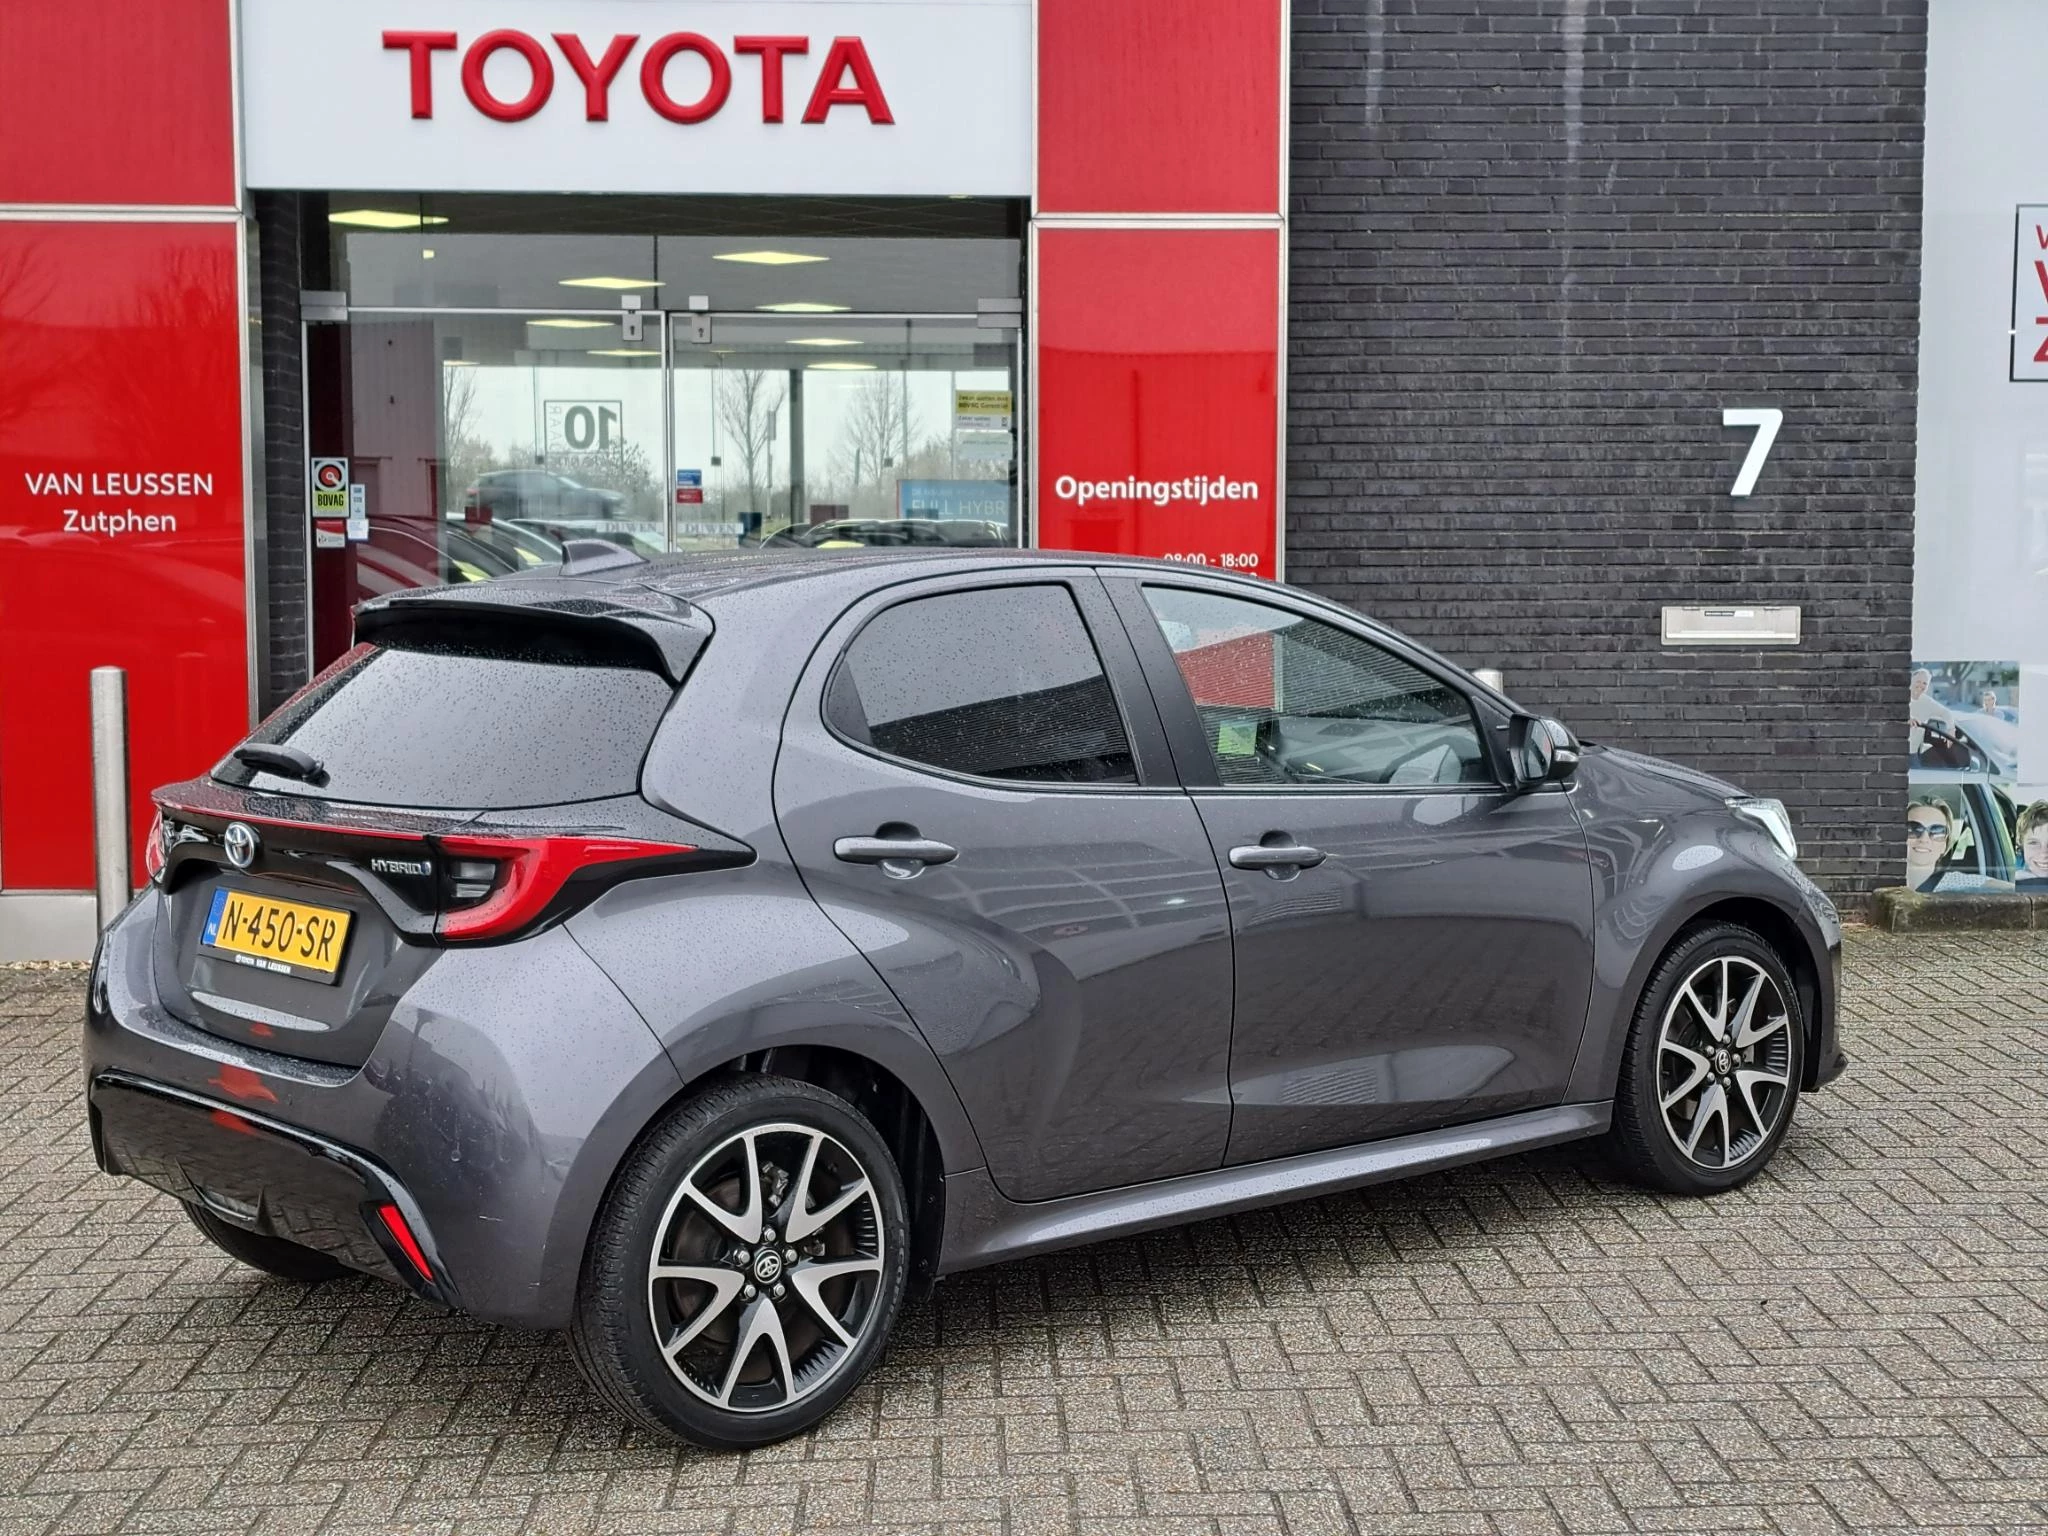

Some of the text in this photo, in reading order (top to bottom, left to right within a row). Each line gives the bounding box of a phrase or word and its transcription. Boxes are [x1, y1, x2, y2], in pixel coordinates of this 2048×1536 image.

[382, 29, 895, 124] TOYOTA
[1723, 409, 1783, 496] 7
[25, 472, 213, 496] VAN LEUSSEN
[1055, 475, 1259, 507] Openingstijden
[317, 494, 344, 507] BOVAG
[63, 509, 176, 538] Zutphen
[1220, 553, 1259, 568] 18:00
[371, 858, 422, 875] HYBRID
[207, 923, 217, 936] NL
[223, 900, 336, 962] N-450-SR
[256, 959, 267, 968] VAN
[268, 961, 292, 974] LEUSSEN
